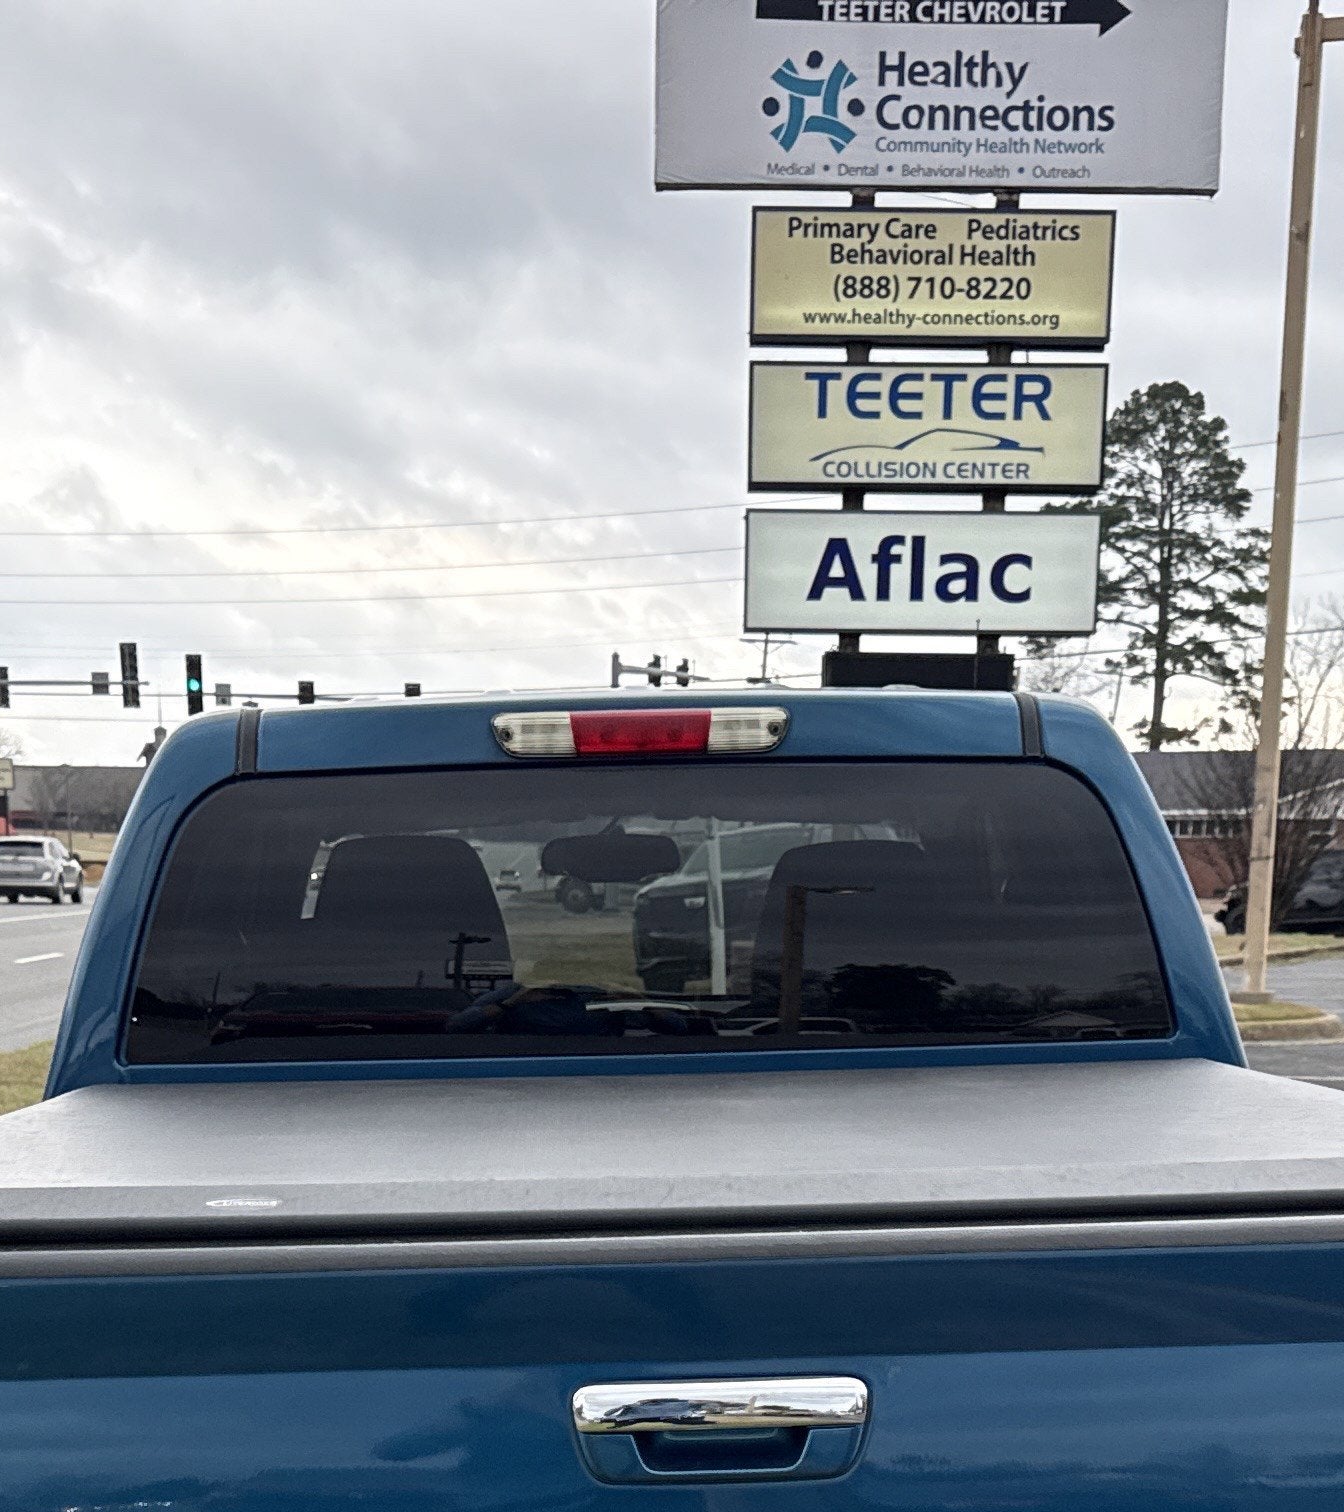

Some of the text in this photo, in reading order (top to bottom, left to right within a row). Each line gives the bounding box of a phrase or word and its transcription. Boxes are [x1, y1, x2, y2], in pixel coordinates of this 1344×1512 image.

[820, 0, 1065, 23] TEETER CHEVROLET
[878, 50, 1030, 99] Healthy
[876, 94, 1115, 132] Connections
[875, 137, 1104, 157] Community Health Network
[767, 163, 1090, 178] Medical Dental Behavioral Health Outreach
[788, 217, 1080, 244] Primary Care Pediatrics
[830, 243, 1036, 266] Behavioral Health
[834, 274, 1032, 302] (888) 710-8220
[803, 309, 1060, 329] www.healthy-connections.org
[804, 372, 1052, 421] TEETER
[823, 461, 1030, 479] COLLISION CENTER
[806, 535, 1033, 603] Aflac
